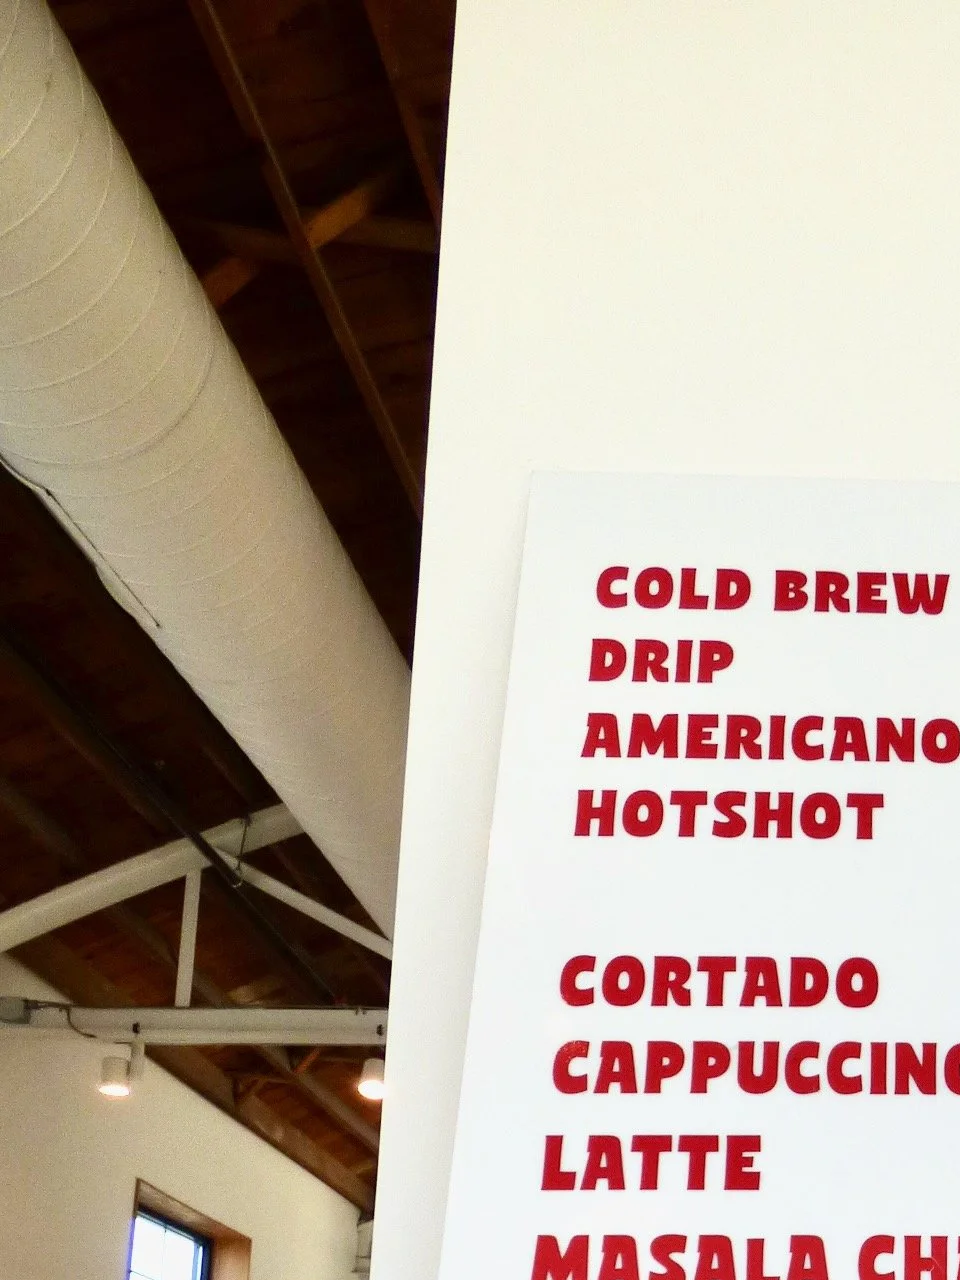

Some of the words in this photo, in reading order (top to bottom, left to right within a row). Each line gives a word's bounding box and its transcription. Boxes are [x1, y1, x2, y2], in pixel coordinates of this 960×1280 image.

[595, 565, 752, 612] COLD
[773, 570, 951, 616] BREW
[588, 637, 735, 684] DRIP
[573, 788, 886, 841] HOTSHOT
[559, 954, 880, 1010] CORTADO
[540, 1134, 763, 1192] LATTE
